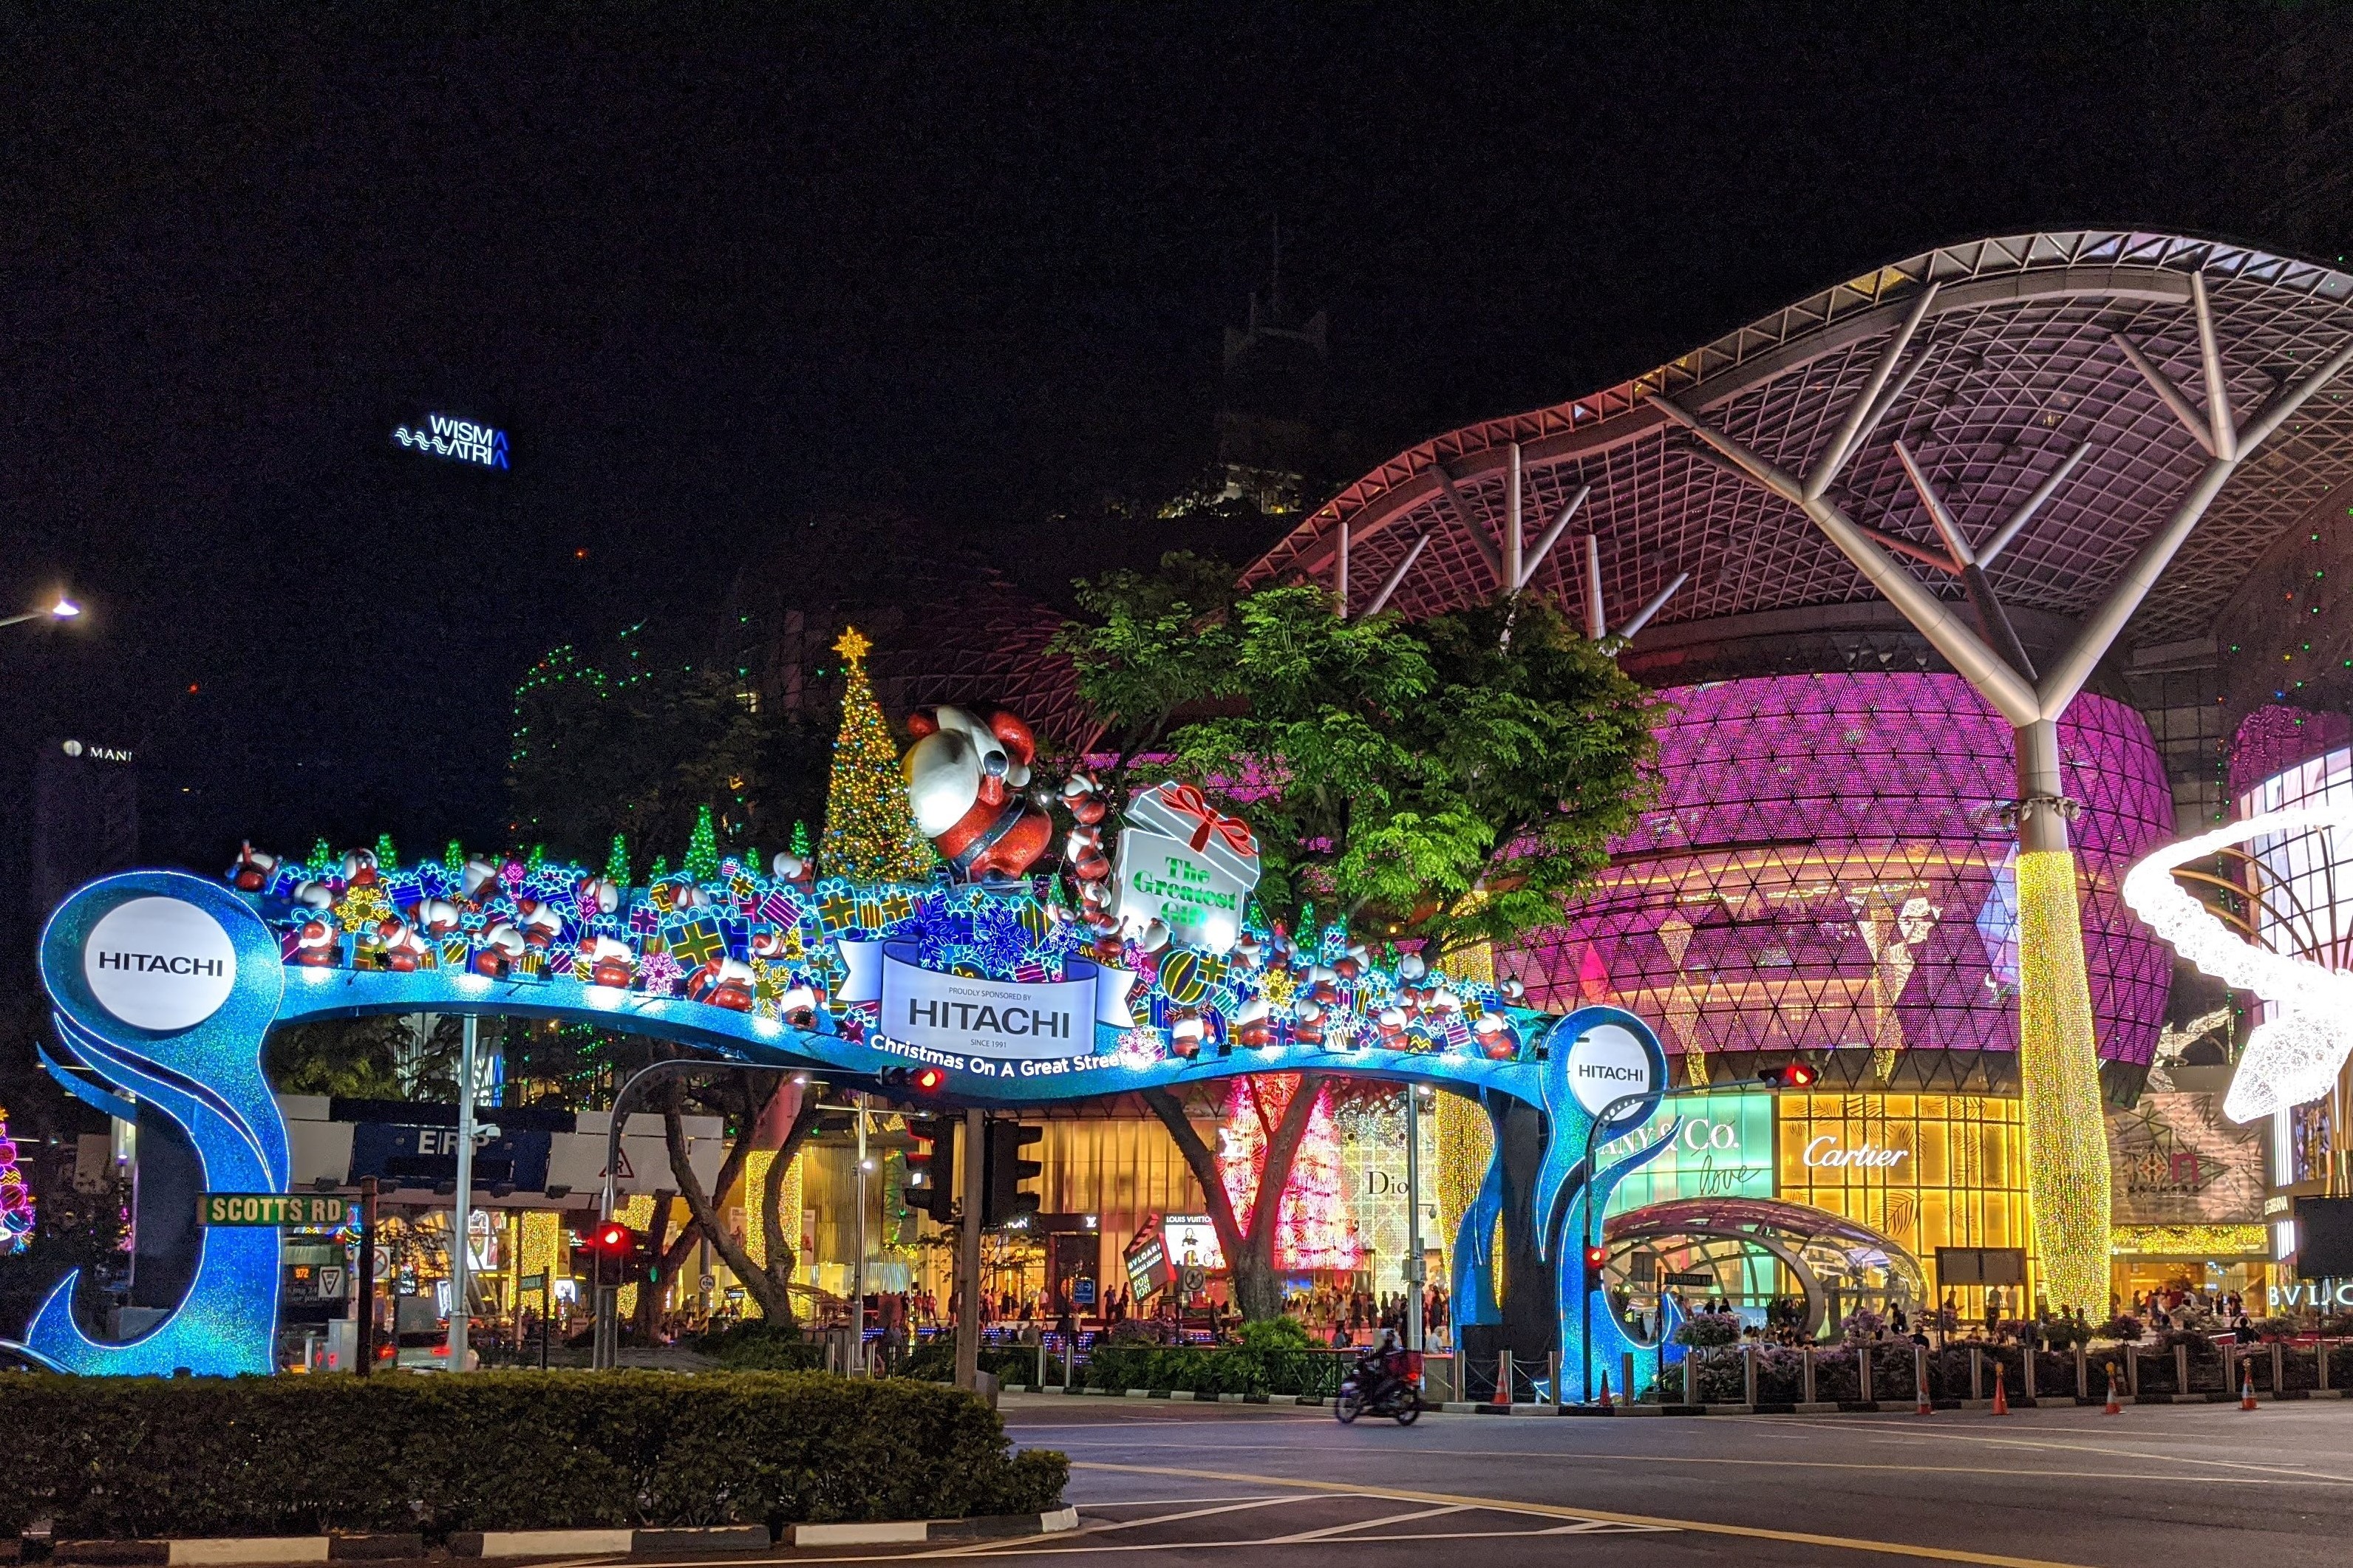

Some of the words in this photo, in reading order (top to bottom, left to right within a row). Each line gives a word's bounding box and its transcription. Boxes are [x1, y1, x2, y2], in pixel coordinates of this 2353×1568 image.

[430, 415, 508, 451] WISMA
[446, 439, 508, 468] ATRIA
[1165, 856, 1210, 884] The
[1132, 870, 1237, 911] Greatest
[99, 951, 223, 977] HITACHI
[949, 987, 981, 998] PROUDLY
[981, 990, 1022, 1001] SPONSORED
[909, 998, 1069, 1038] HITACHI
[870, 1034, 964, 1070] Christmas
[970, 1057, 995, 1077] On
[1000, 1061, 1015, 1077] A
[1020, 1058, 1070, 1077] Great
[1073, 1054, 1121, 1071] Stree
[970, 1038, 990, 1047] SINCE
[992, 1040, 1007, 1049] 1991
[1579, 1064, 1643, 1083] HITACHI
[1802, 1136, 1909, 1167] Cartier
[1367, 1171, 1410, 1195] Dio
[1699, 1154, 1762, 1196] love
[211, 1197, 303, 1221] SCOTTS
[311, 1199, 341, 1222] RD
[296, 1268, 309, 1278] 972
